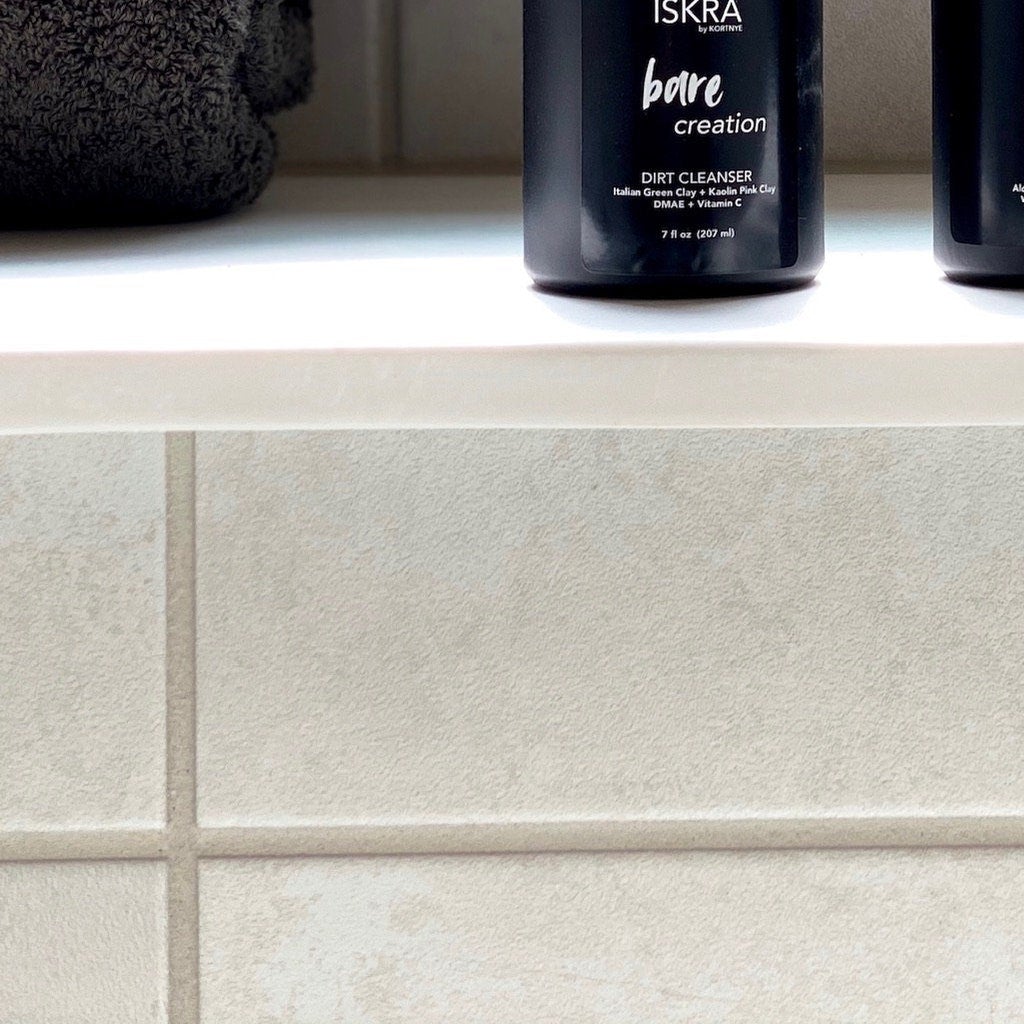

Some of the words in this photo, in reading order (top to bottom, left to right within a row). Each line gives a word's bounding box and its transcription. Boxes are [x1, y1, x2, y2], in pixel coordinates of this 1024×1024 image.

[698, 25, 707, 34] by
[708, 24, 743, 32] KORTNYE
[642, 57, 724, 110] bare
[674, 112, 767, 134] creation
[641, 172, 675, 184] DIRT
[678, 170, 752, 184] CLEANSER
[613, 186, 641, 196] Italian
[643, 188, 673, 197] Green
[675, 187, 697, 199] Clay
[708, 187, 737, 196] Kaolin
[739, 185, 757, 194] Pink
[759, 184, 776, 195] Clay
[653, 200, 685, 208] DMAE
[697, 199, 733, 208] Vitamin
[735, 198, 742, 207] C
[661, 230, 667, 239] 7
[670, 230, 677, 239] fl
[696, 229, 717, 239] (207
[720, 228, 735, 238] ml)
